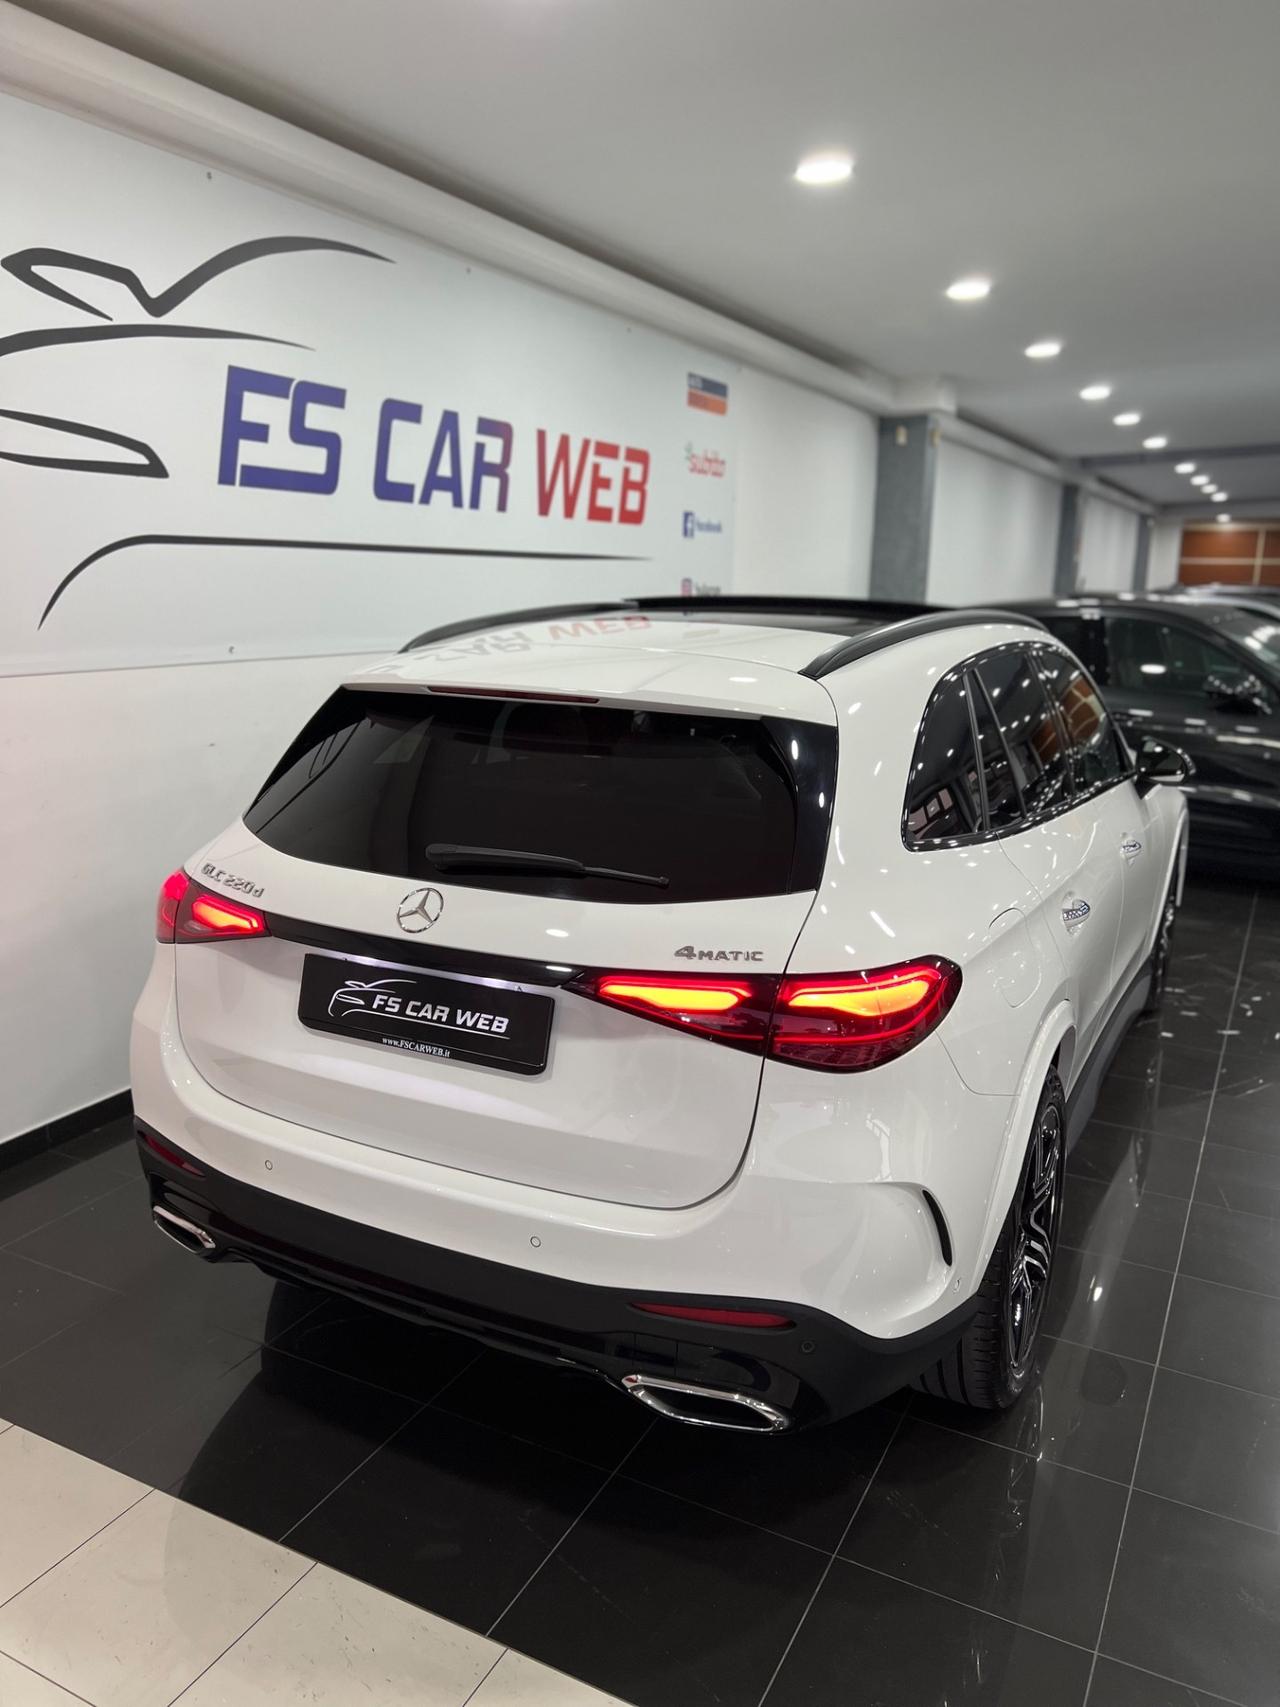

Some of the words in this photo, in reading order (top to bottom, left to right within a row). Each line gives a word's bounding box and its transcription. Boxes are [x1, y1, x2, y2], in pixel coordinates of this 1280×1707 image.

[217, 364, 347, 495] FS
[373, 397, 514, 513] CAR
[536, 427, 651, 526] WEB
[201, 863, 226, 882] GLC
[223, 873, 265, 898] 220d
[674, 945, 764, 961] 4MATIC
[372, 994, 402, 1013] FS
[405, 1000, 450, 1022] CAR
[456, 1008, 509, 1033] WEB
[382, 1037, 451, 1058] www.FSCARWEB.it
